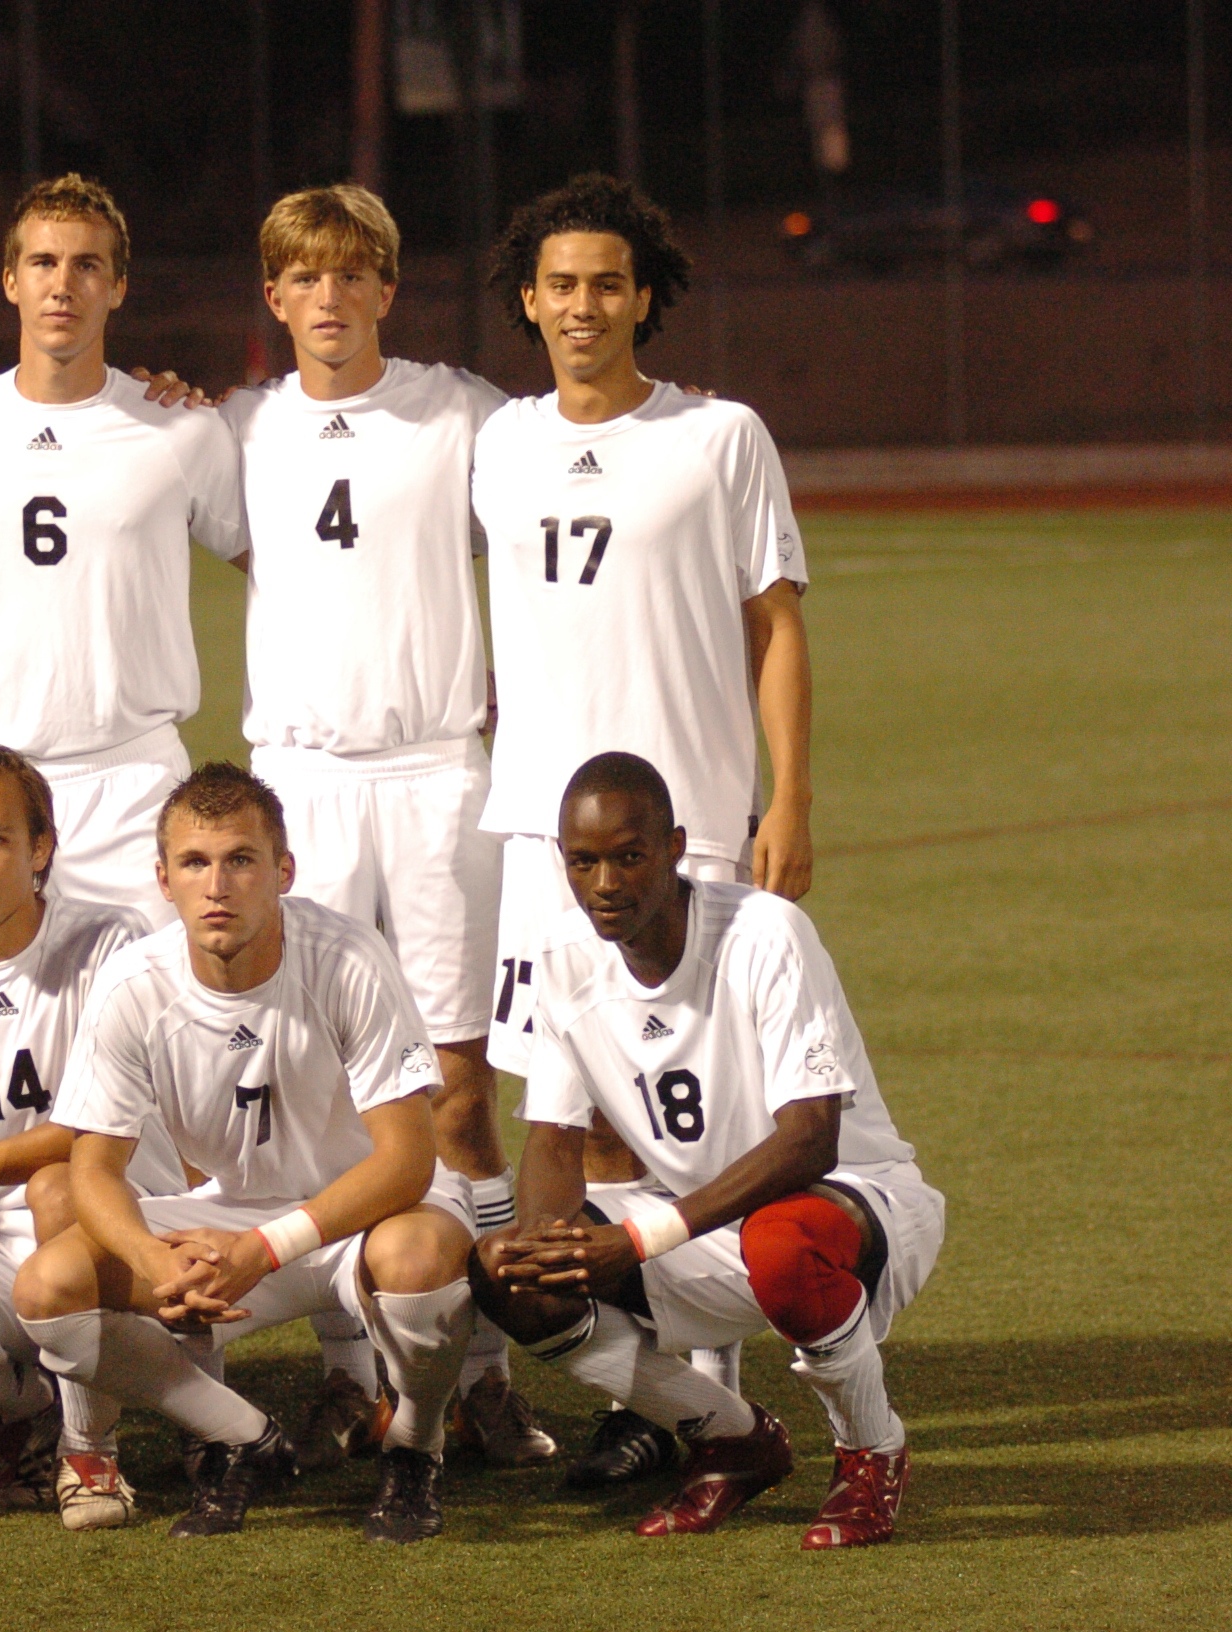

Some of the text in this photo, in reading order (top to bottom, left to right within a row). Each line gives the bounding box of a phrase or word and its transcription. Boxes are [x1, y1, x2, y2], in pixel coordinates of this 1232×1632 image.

[27, 443, 63, 451] adidas
[319, 430, 355, 439] adidas
[568, 466, 603, 475] adidas
[24, 497, 67, 566] 6
[315, 479, 359, 549] 4
[540, 516, 613, 585] 17
[227, 1038, 264, 1051] adidas
[642, 1029, 675, 1041] adidas
[235, 1082, 273, 1147] 7
[634, 1068, 705, 1143] 18
